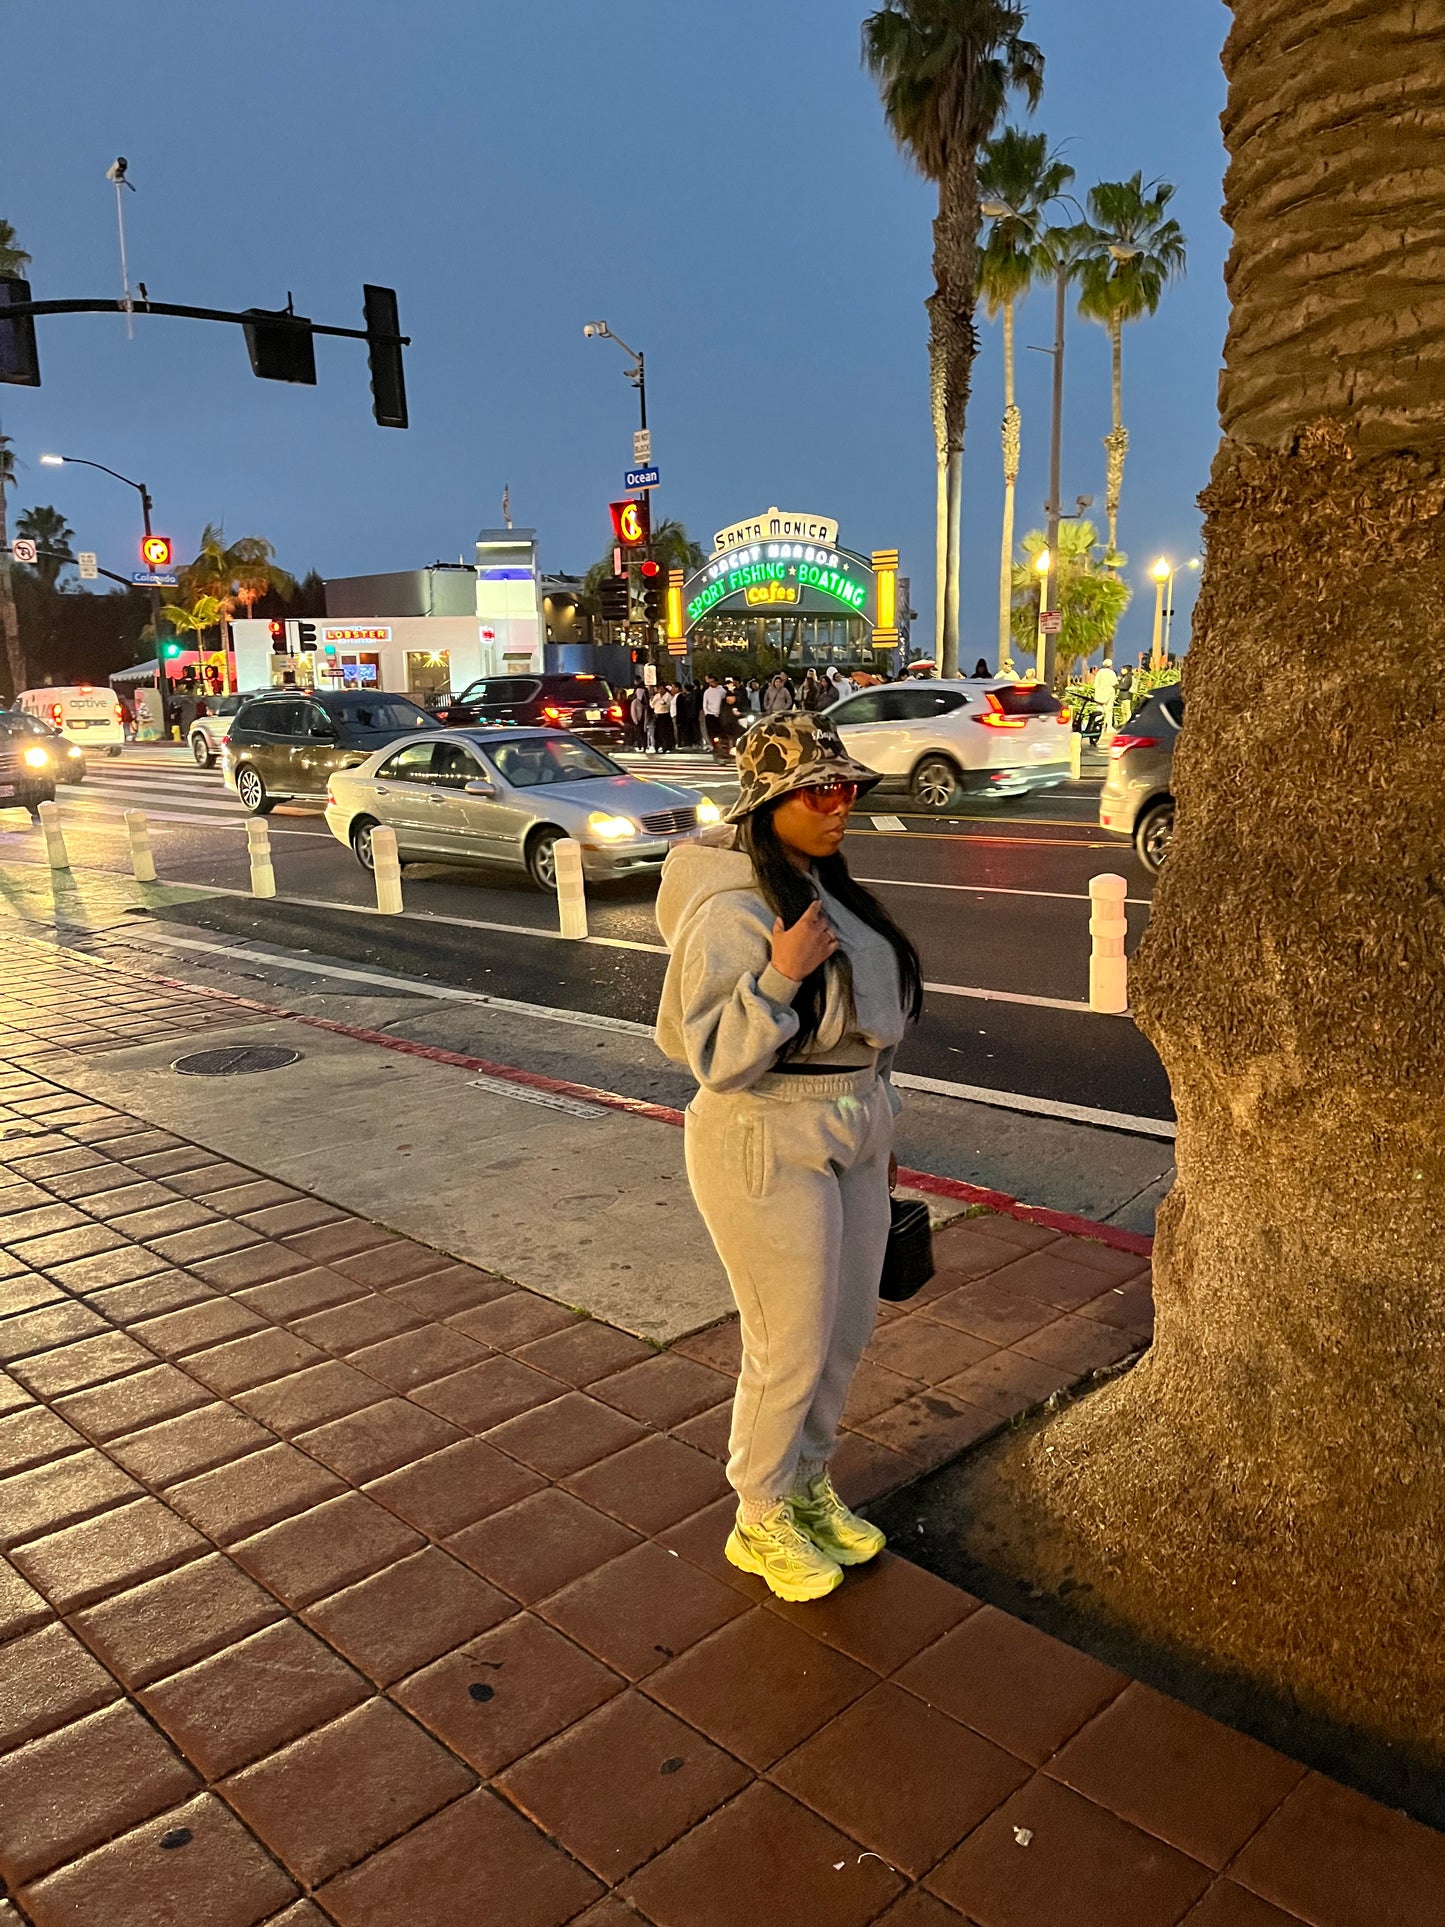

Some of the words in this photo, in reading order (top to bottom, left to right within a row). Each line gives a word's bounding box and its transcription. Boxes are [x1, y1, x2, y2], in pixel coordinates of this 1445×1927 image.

[627, 472, 657, 484] Ocean
[716, 524, 761, 551] SANTA
[770, 519, 828, 544] MONICA
[709, 545, 761, 578] YACHT
[768, 544, 839, 568] HARBOR
[688, 578, 725, 619] SPORT
[730, 562, 785, 590] FISHING
[799, 564, 866, 606] BOATING
[327, 630, 385, 639] LOBSTER
[70, 697, 107, 710] aptive
